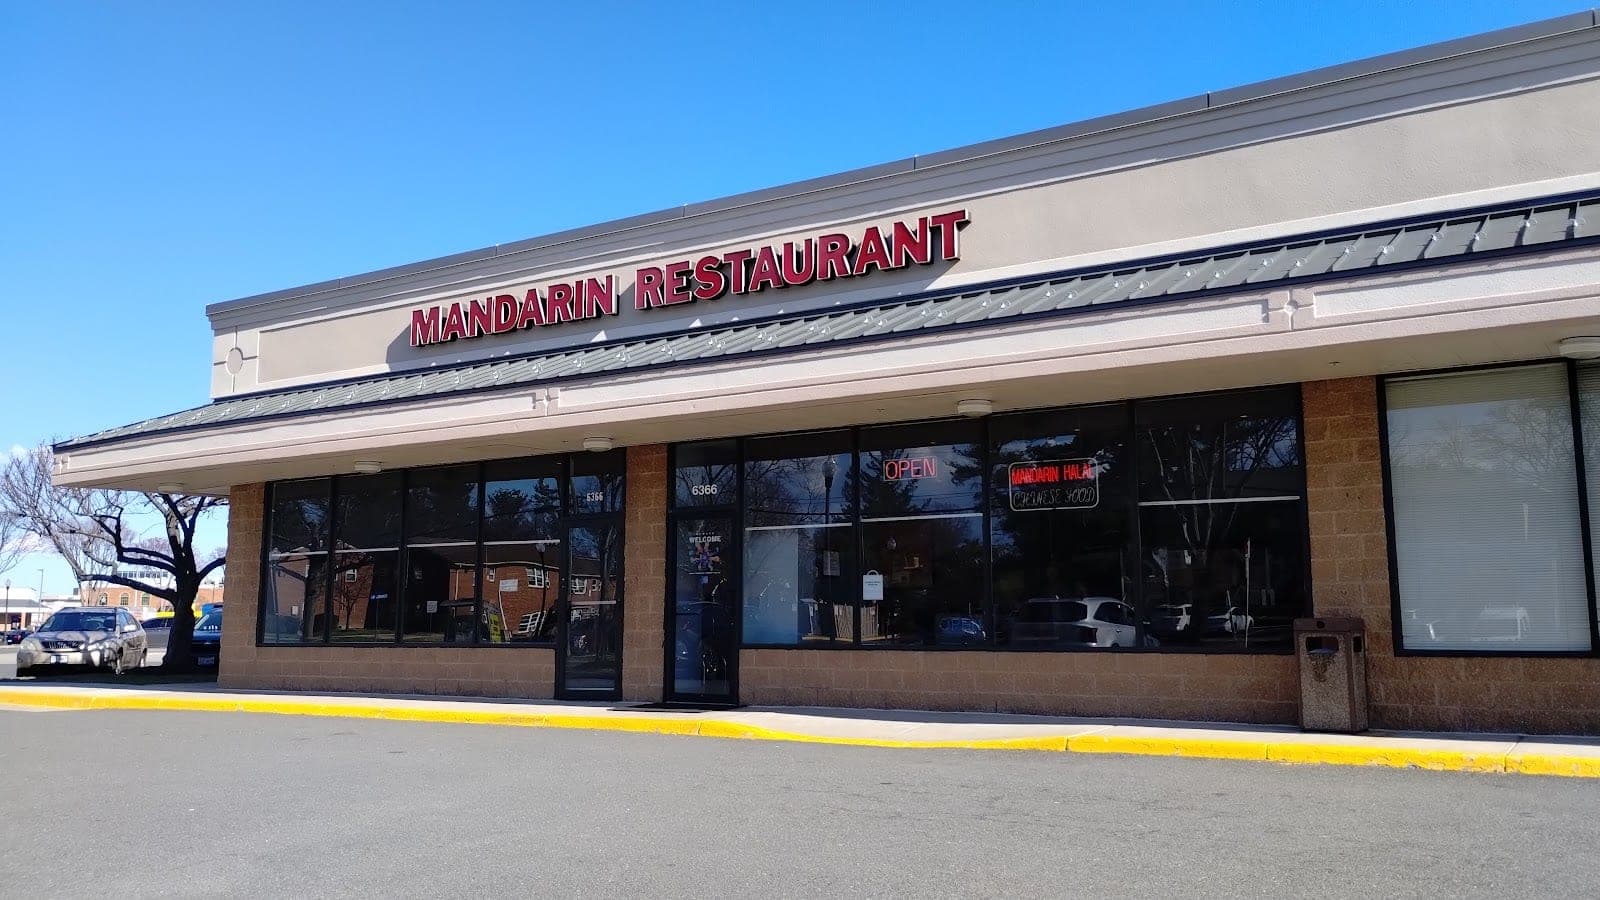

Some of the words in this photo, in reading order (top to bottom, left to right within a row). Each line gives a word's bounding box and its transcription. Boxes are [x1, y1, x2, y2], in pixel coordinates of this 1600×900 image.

[409, 276, 618, 346] MANDARIN
[635, 209, 969, 310] RESTAURANT
[885, 457, 936, 479] OPEN
[1011, 466, 1059, 485] MANDARIN
[1064, 463, 1095, 480] HALAL
[587, 491, 604, 502] 6366
[692, 484, 718, 496] 6366
[1012, 488, 1061, 507] CHINESE
[1065, 486, 1095, 503] FOOD
[689, 535, 721, 543] WELCOME
